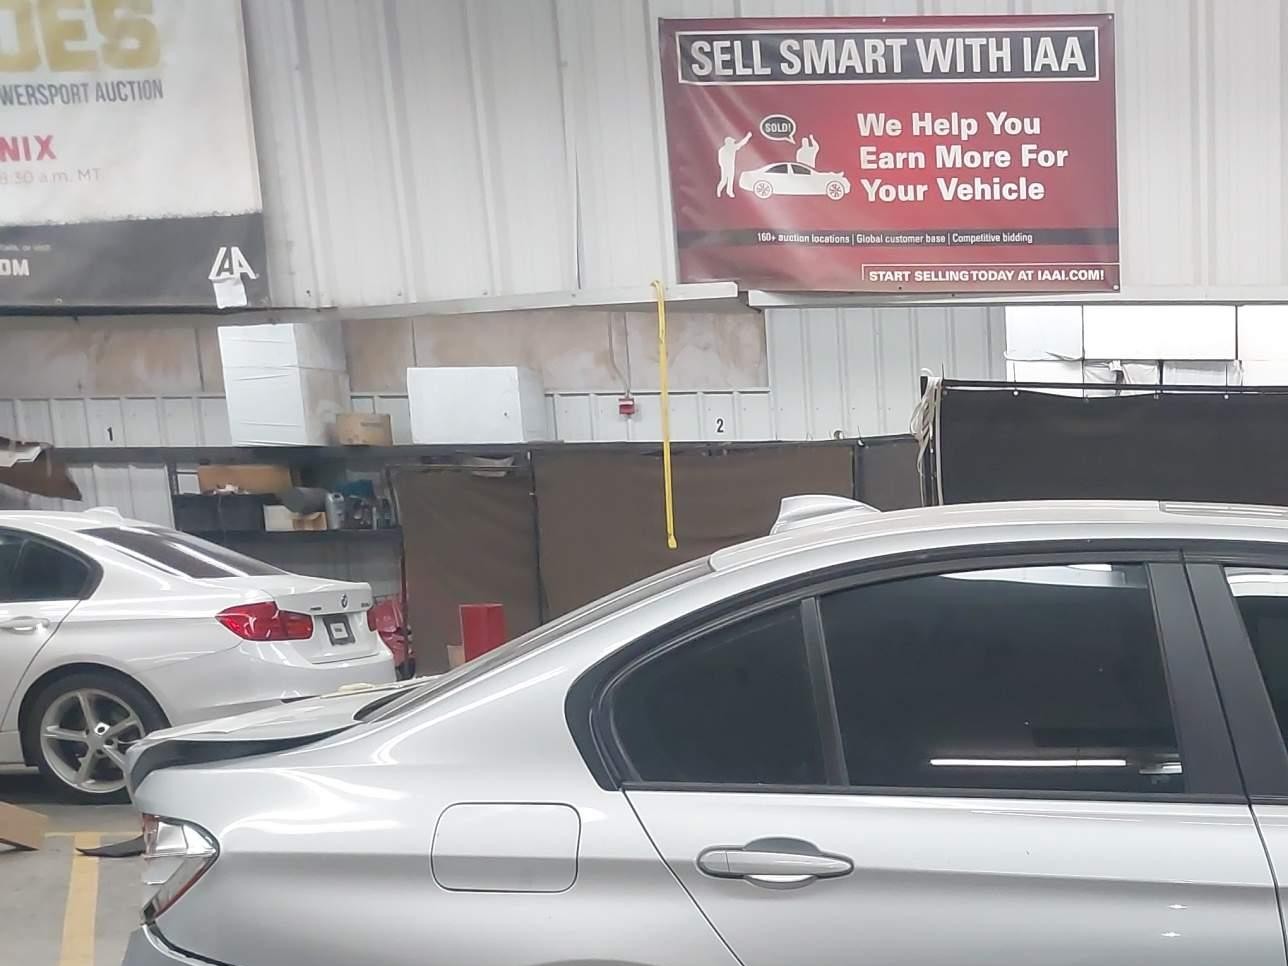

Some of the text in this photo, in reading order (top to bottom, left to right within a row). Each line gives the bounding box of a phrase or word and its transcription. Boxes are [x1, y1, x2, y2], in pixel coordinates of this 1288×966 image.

[691, 36, 1086, 76] SELL SMART WITH IAA
[95, 79, 164, 102] AUCTION
[764, 123, 792, 133] SOLD!
[857, 112, 1041, 141] We Help You
[861, 144, 1069, 169] Earn More For
[861, 177, 1045, 202] Your Vehicle
[757, 233, 777, 242] 160+
[811, 233, 850, 243] locations
[856, 233, 883, 243] Global
[885, 234, 924, 243] customer
[926, 234, 946, 243] base
[952, 233, 1000, 245] Competitive
[1002, 232, 1033, 244] bidding
[869, 270, 1105, 282] START SELLING TODAY AT IAAI.COM!
[107, 427, 113, 441] 1
[716, 418, 724, 433] 2
